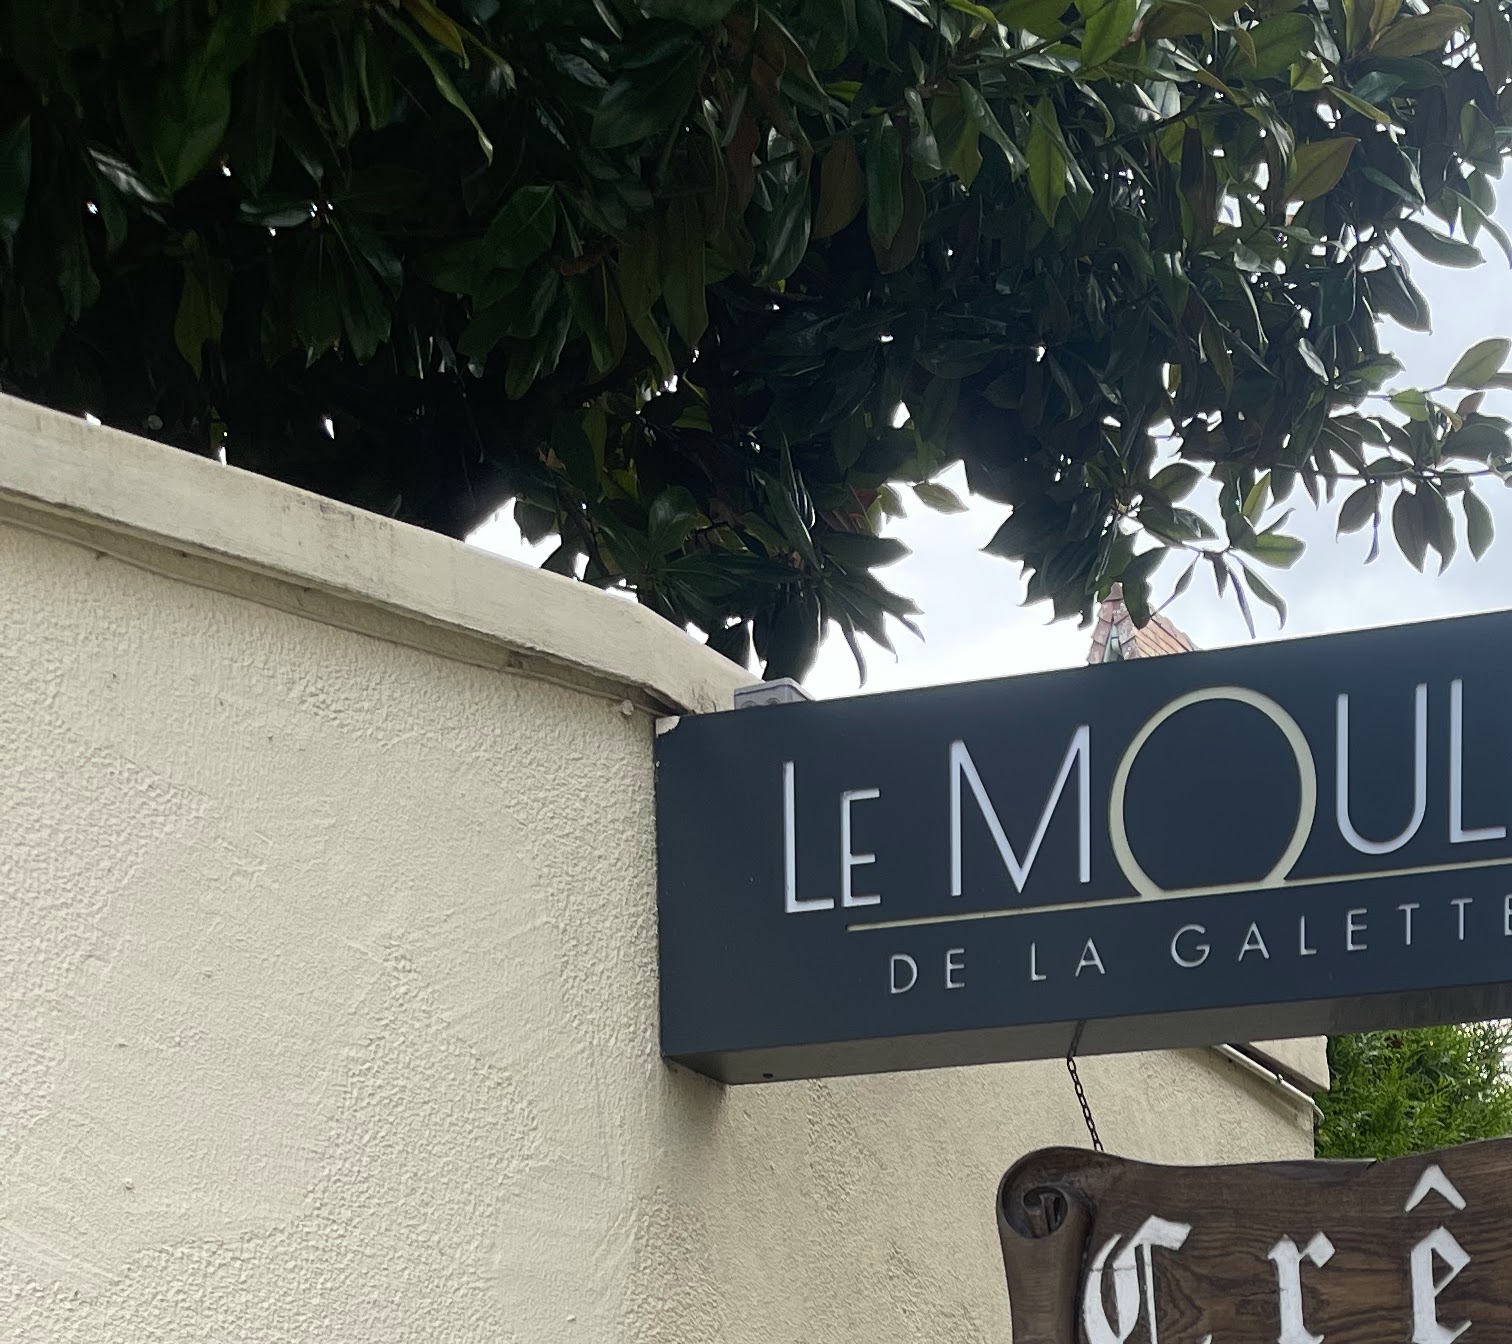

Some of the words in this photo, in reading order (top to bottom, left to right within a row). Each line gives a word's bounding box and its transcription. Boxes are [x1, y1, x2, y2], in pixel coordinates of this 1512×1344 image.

[783, 760, 881, 914] LE
[889, 947, 966, 996] DE
[1029, 936, 1105, 982] LA
